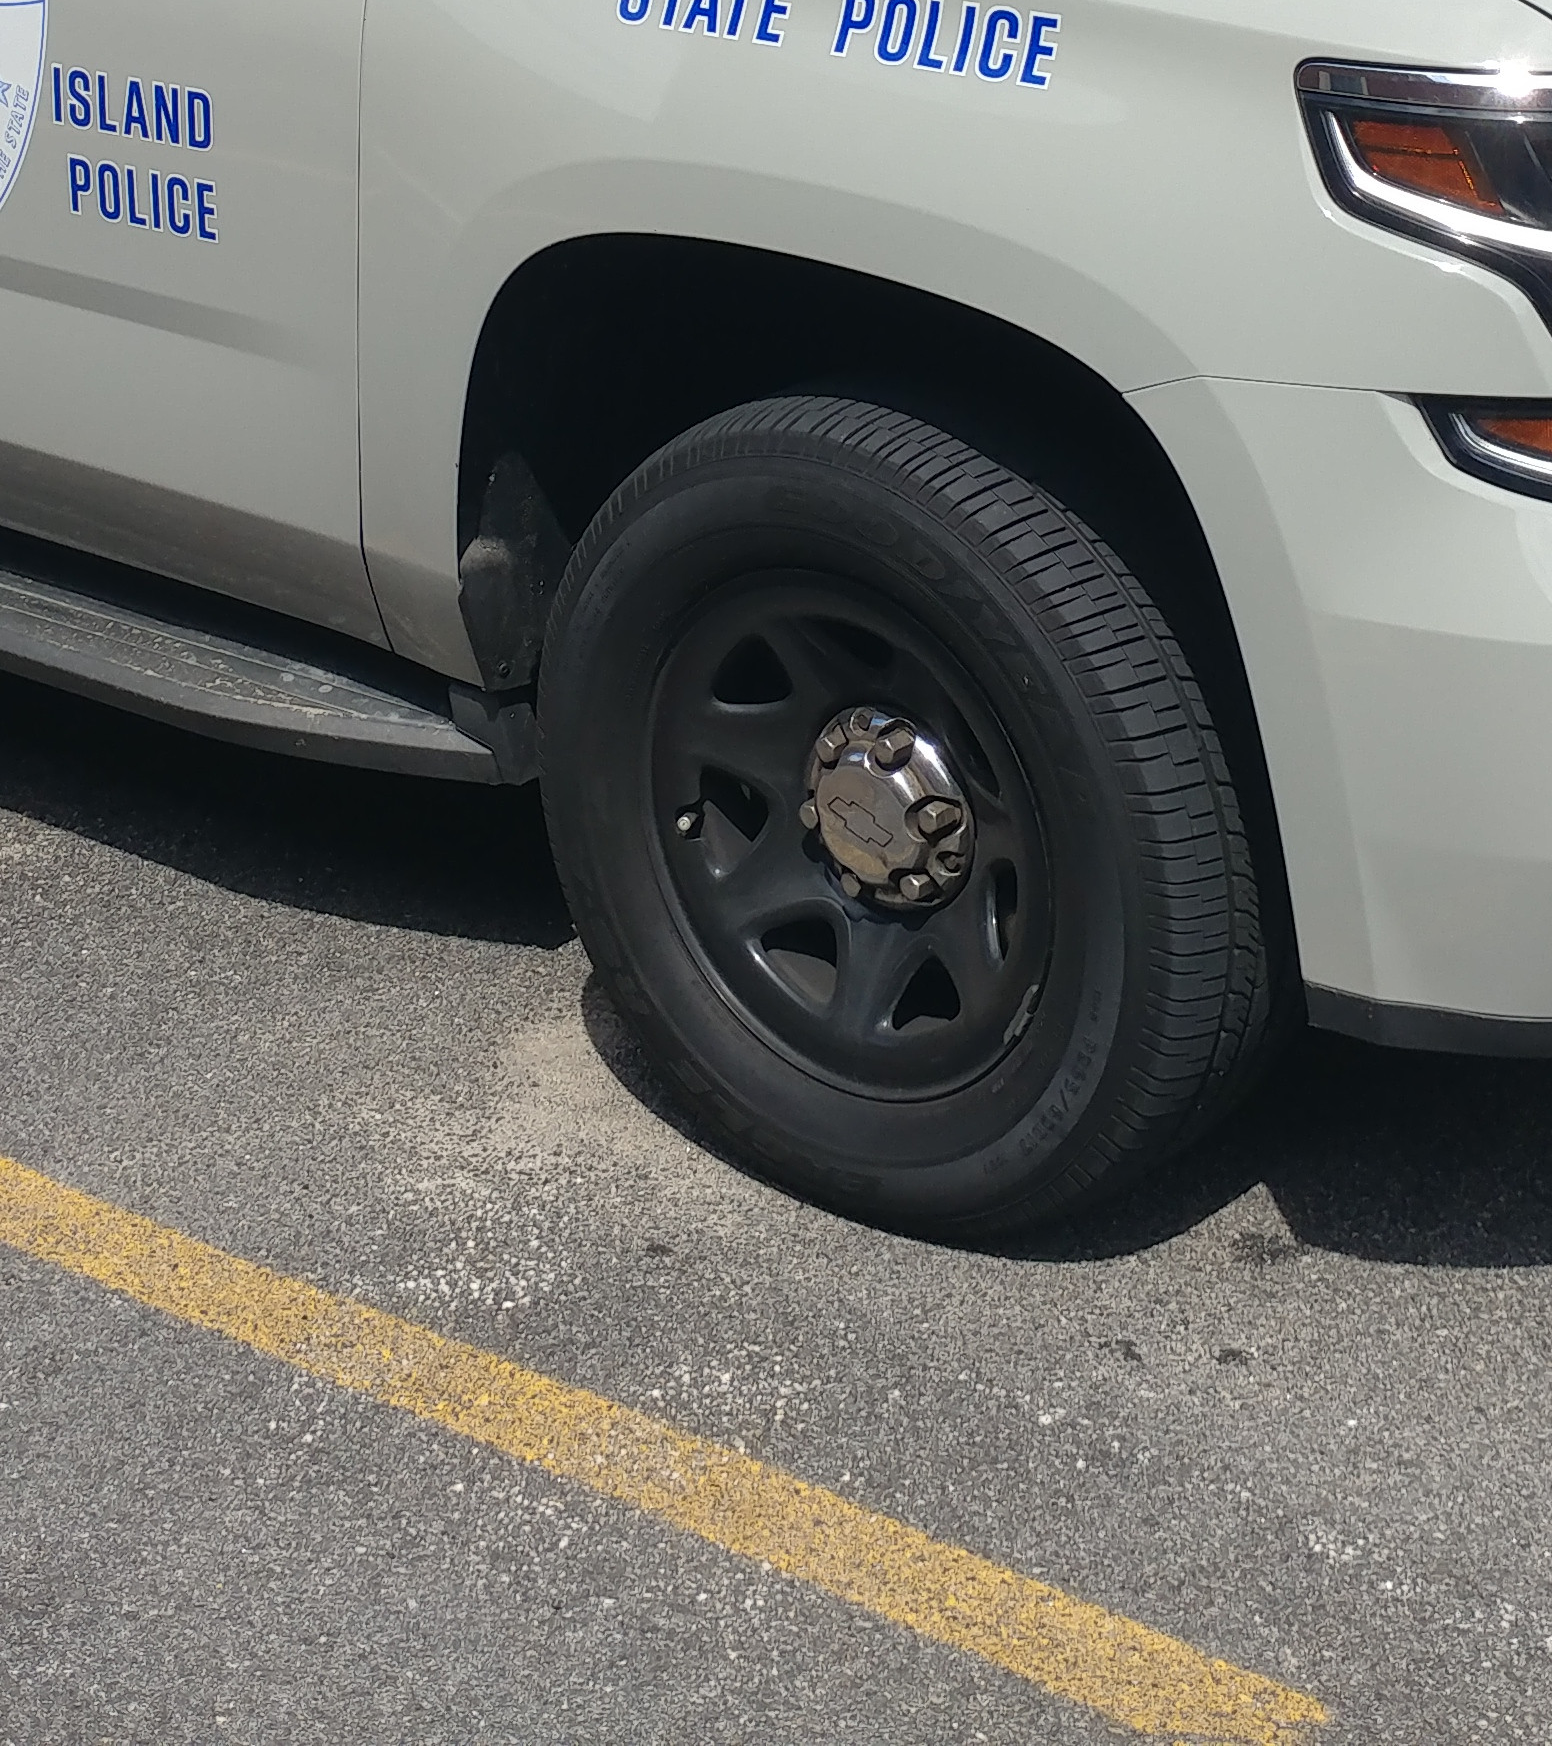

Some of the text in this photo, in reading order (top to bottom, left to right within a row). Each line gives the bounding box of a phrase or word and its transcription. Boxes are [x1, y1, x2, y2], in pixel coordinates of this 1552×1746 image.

[4, 84, 30, 150] STATE
[52, 65, 213, 151] ISLAND
[67, 157, 217, 242] POLICE
